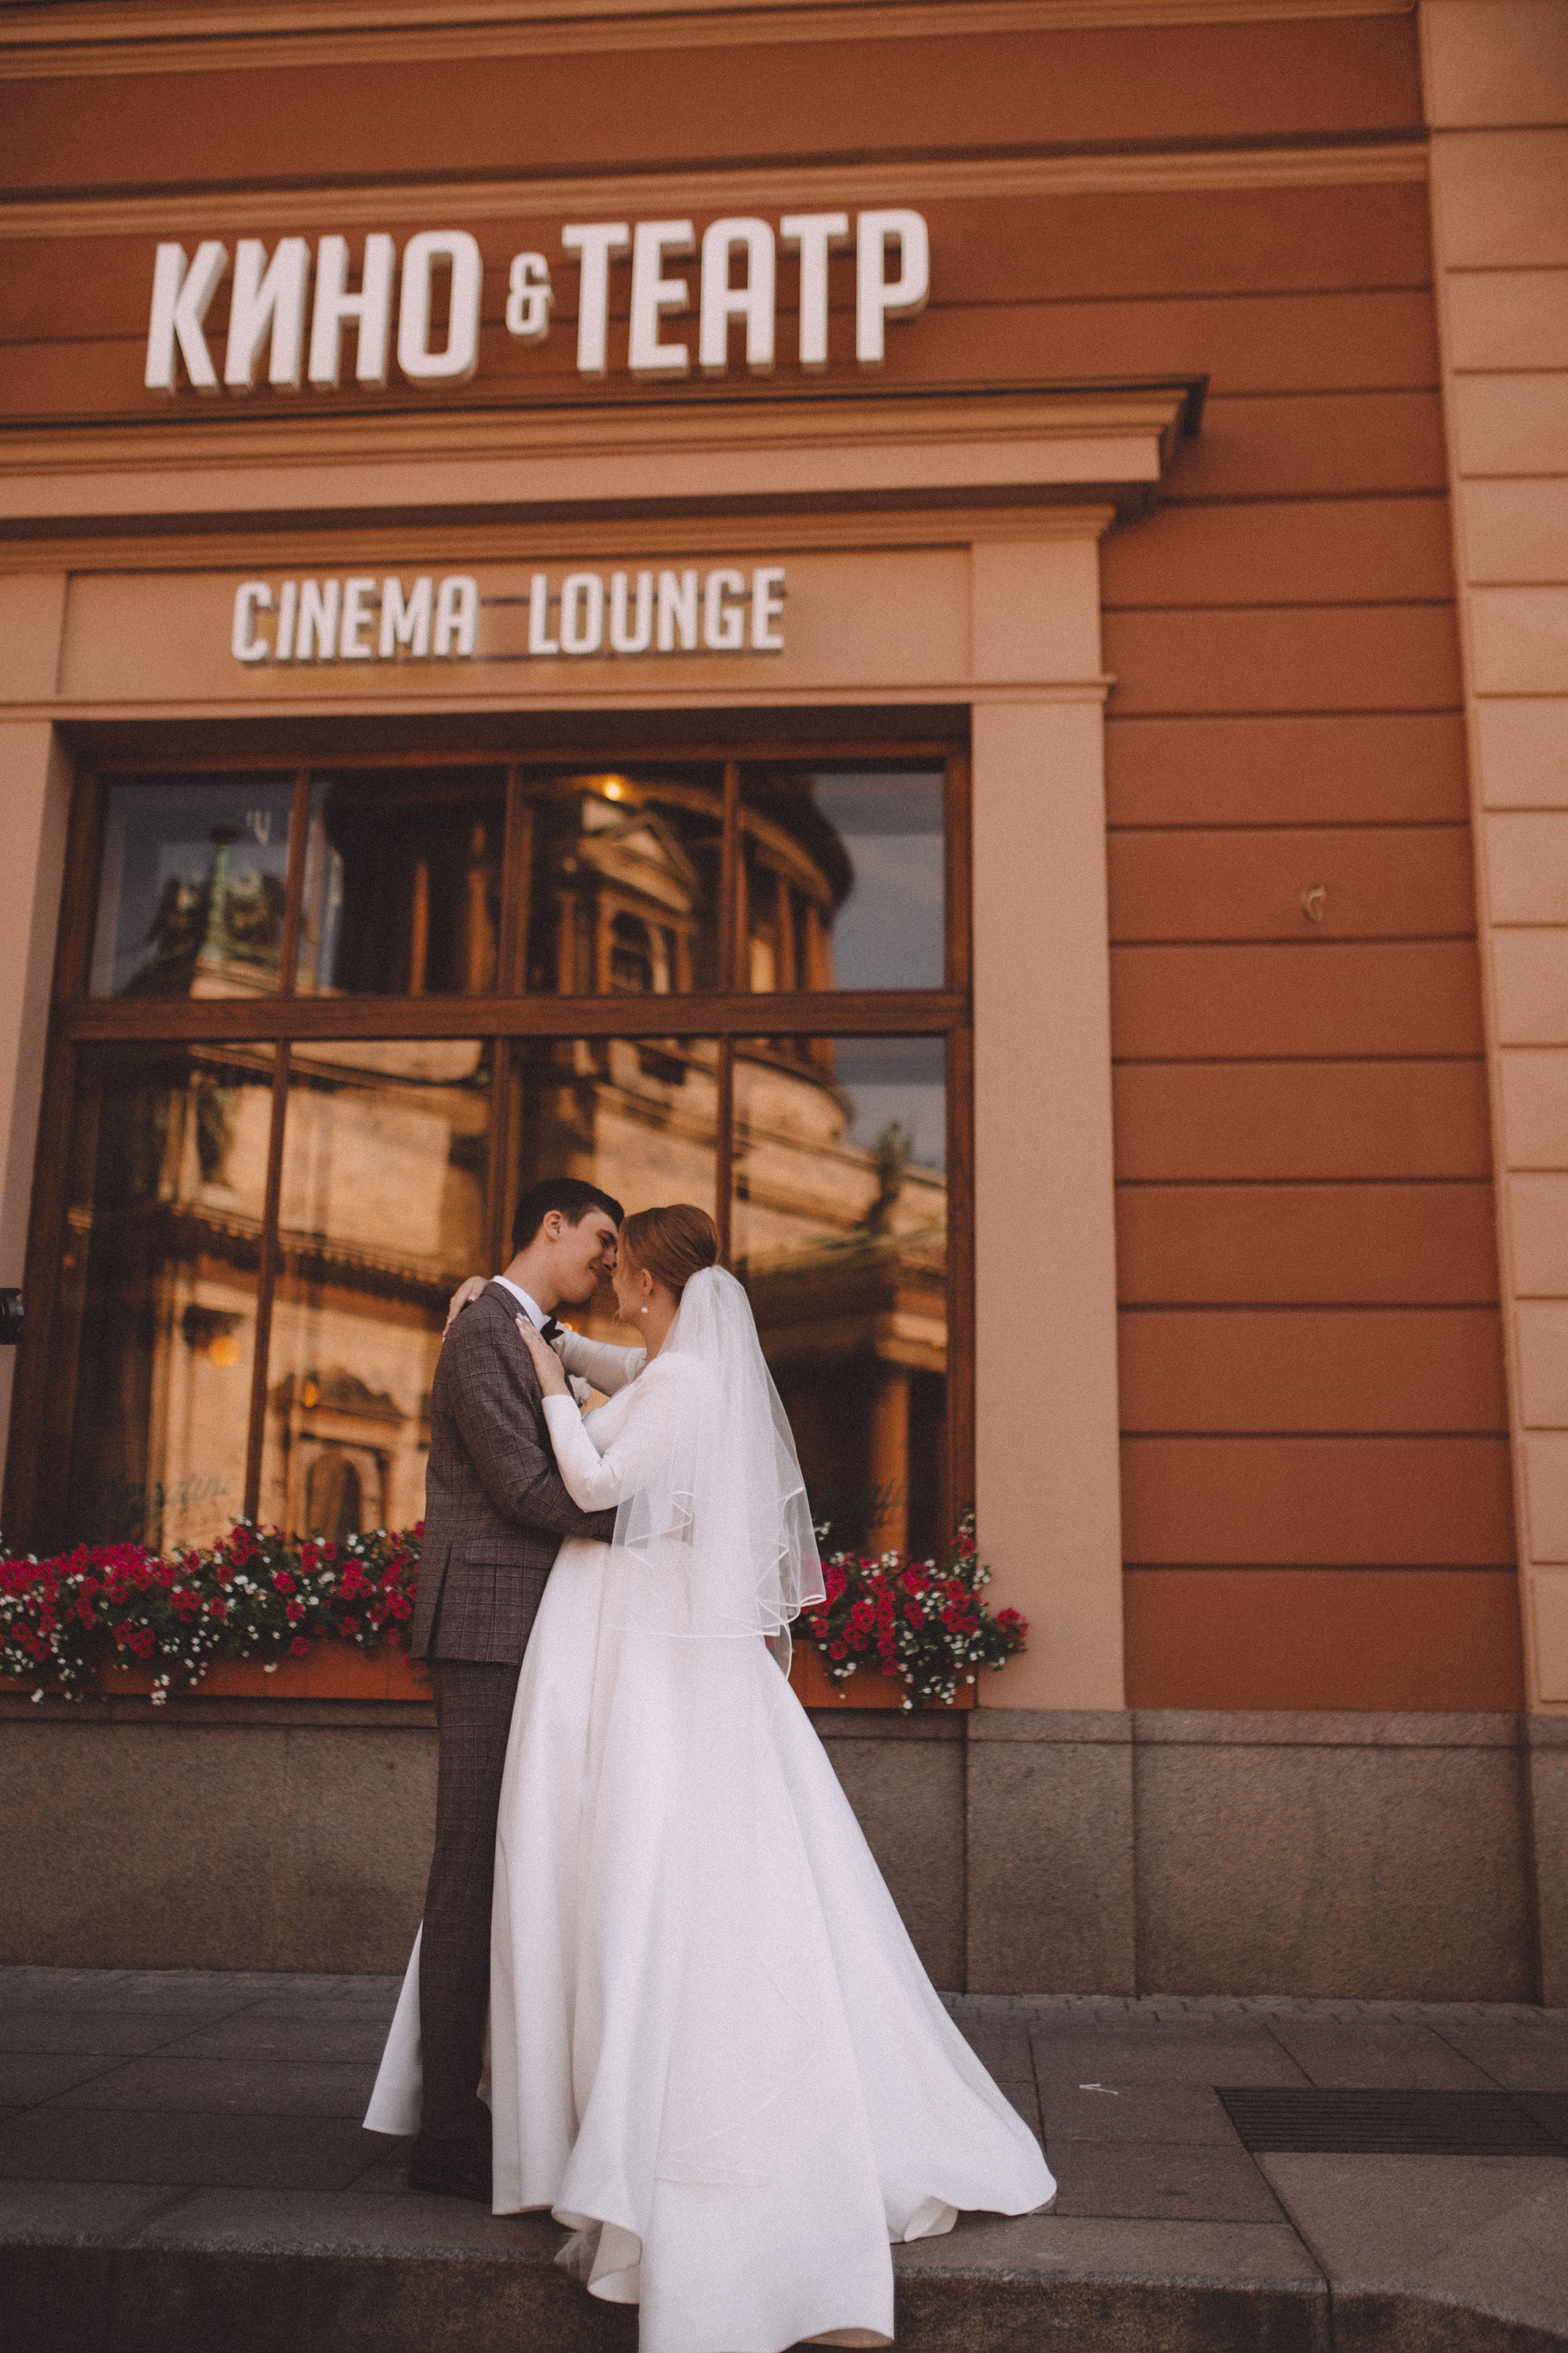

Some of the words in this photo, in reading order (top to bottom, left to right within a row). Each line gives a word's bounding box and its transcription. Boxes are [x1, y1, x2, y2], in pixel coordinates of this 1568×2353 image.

[145, 230, 483, 396] КИНО
[505, 251, 552, 344] &
[561, 209, 932, 381] ТЕАТР
[232, 574, 479, 663] CINEMA
[527, 567, 785, 658] LOUNGE
